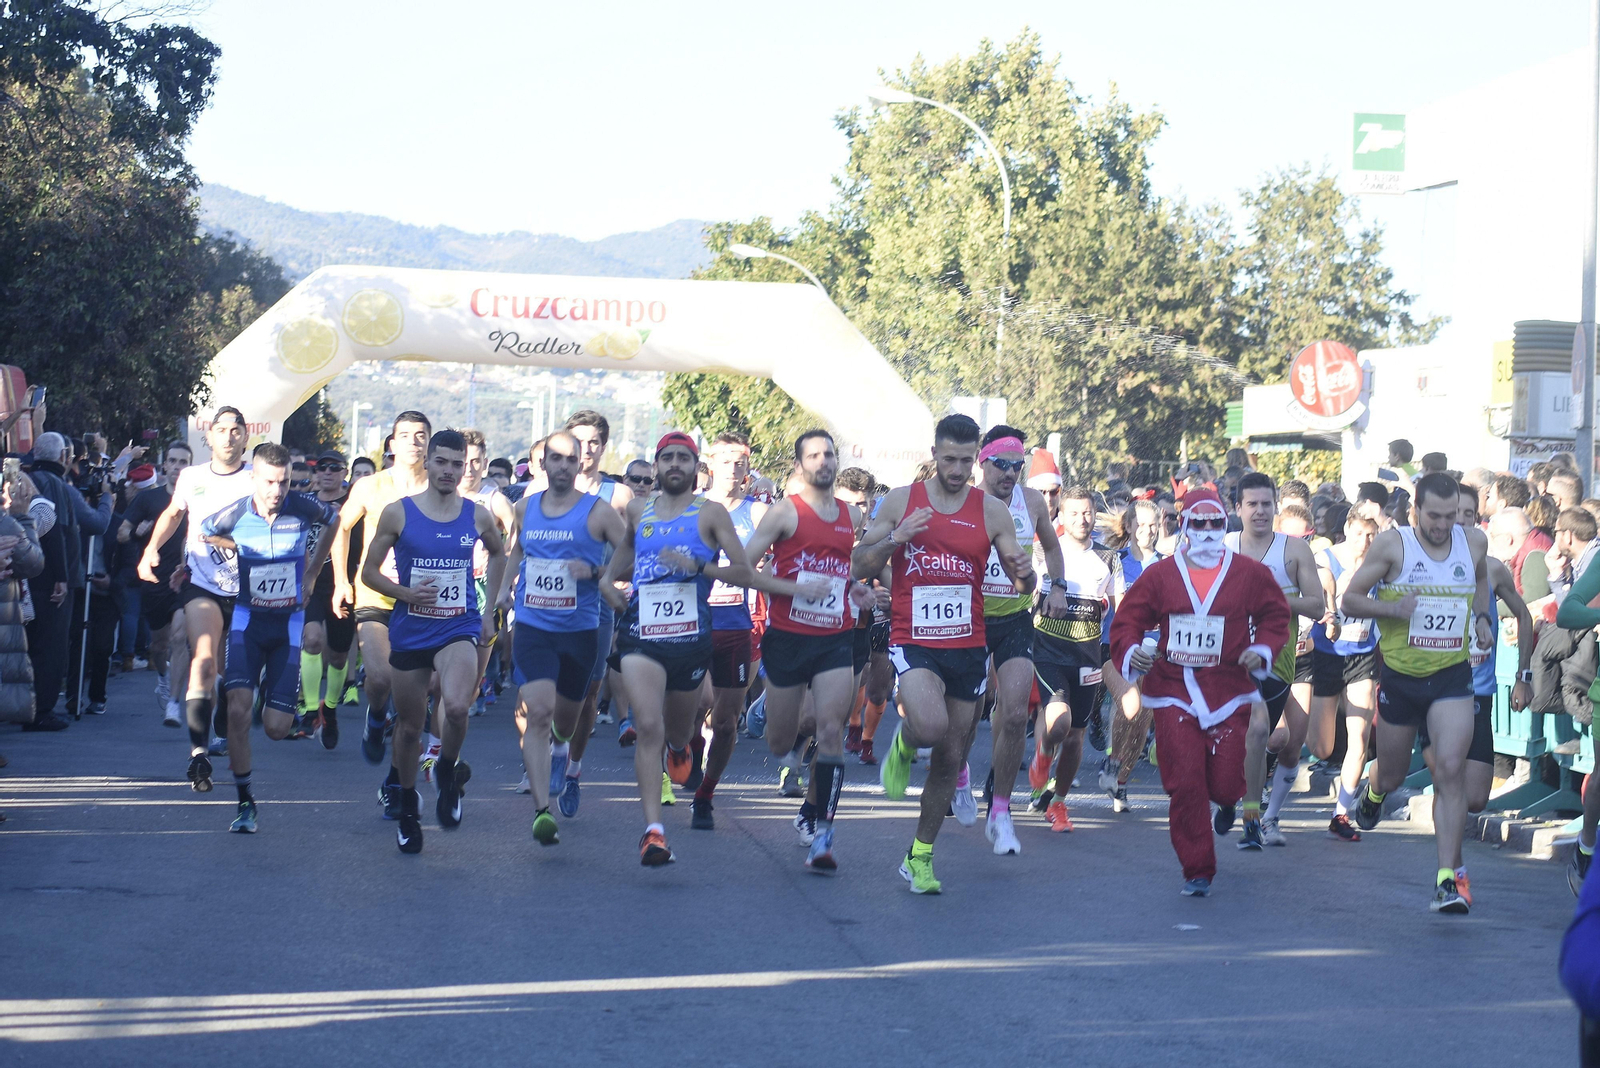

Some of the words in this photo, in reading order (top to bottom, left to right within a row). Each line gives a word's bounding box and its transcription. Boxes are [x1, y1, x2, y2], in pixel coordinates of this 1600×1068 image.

[469, 287, 666, 328] Cruzcampo
[488, 330, 584, 358] Radler
[526, 529, 573, 542] TROTASIERRA
[412, 557, 471, 568] TROTASIERRA
[921, 553, 974, 574] califas
[257, 578, 288, 594] 477
[534, 574, 565, 592] 468
[430, 584, 460, 602] 43
[413, 604, 456, 617] Cruzcampo
[652, 599, 685, 618] 792
[921, 602, 963, 620] 1161
[645, 621, 689, 635] Cruzcampo
[918, 626, 962, 637] Cruzcampo
[1423, 614, 1457, 632] 327
[1175, 630, 1216, 650] 1115
[1414, 636, 1456, 650] Cruzcampo
